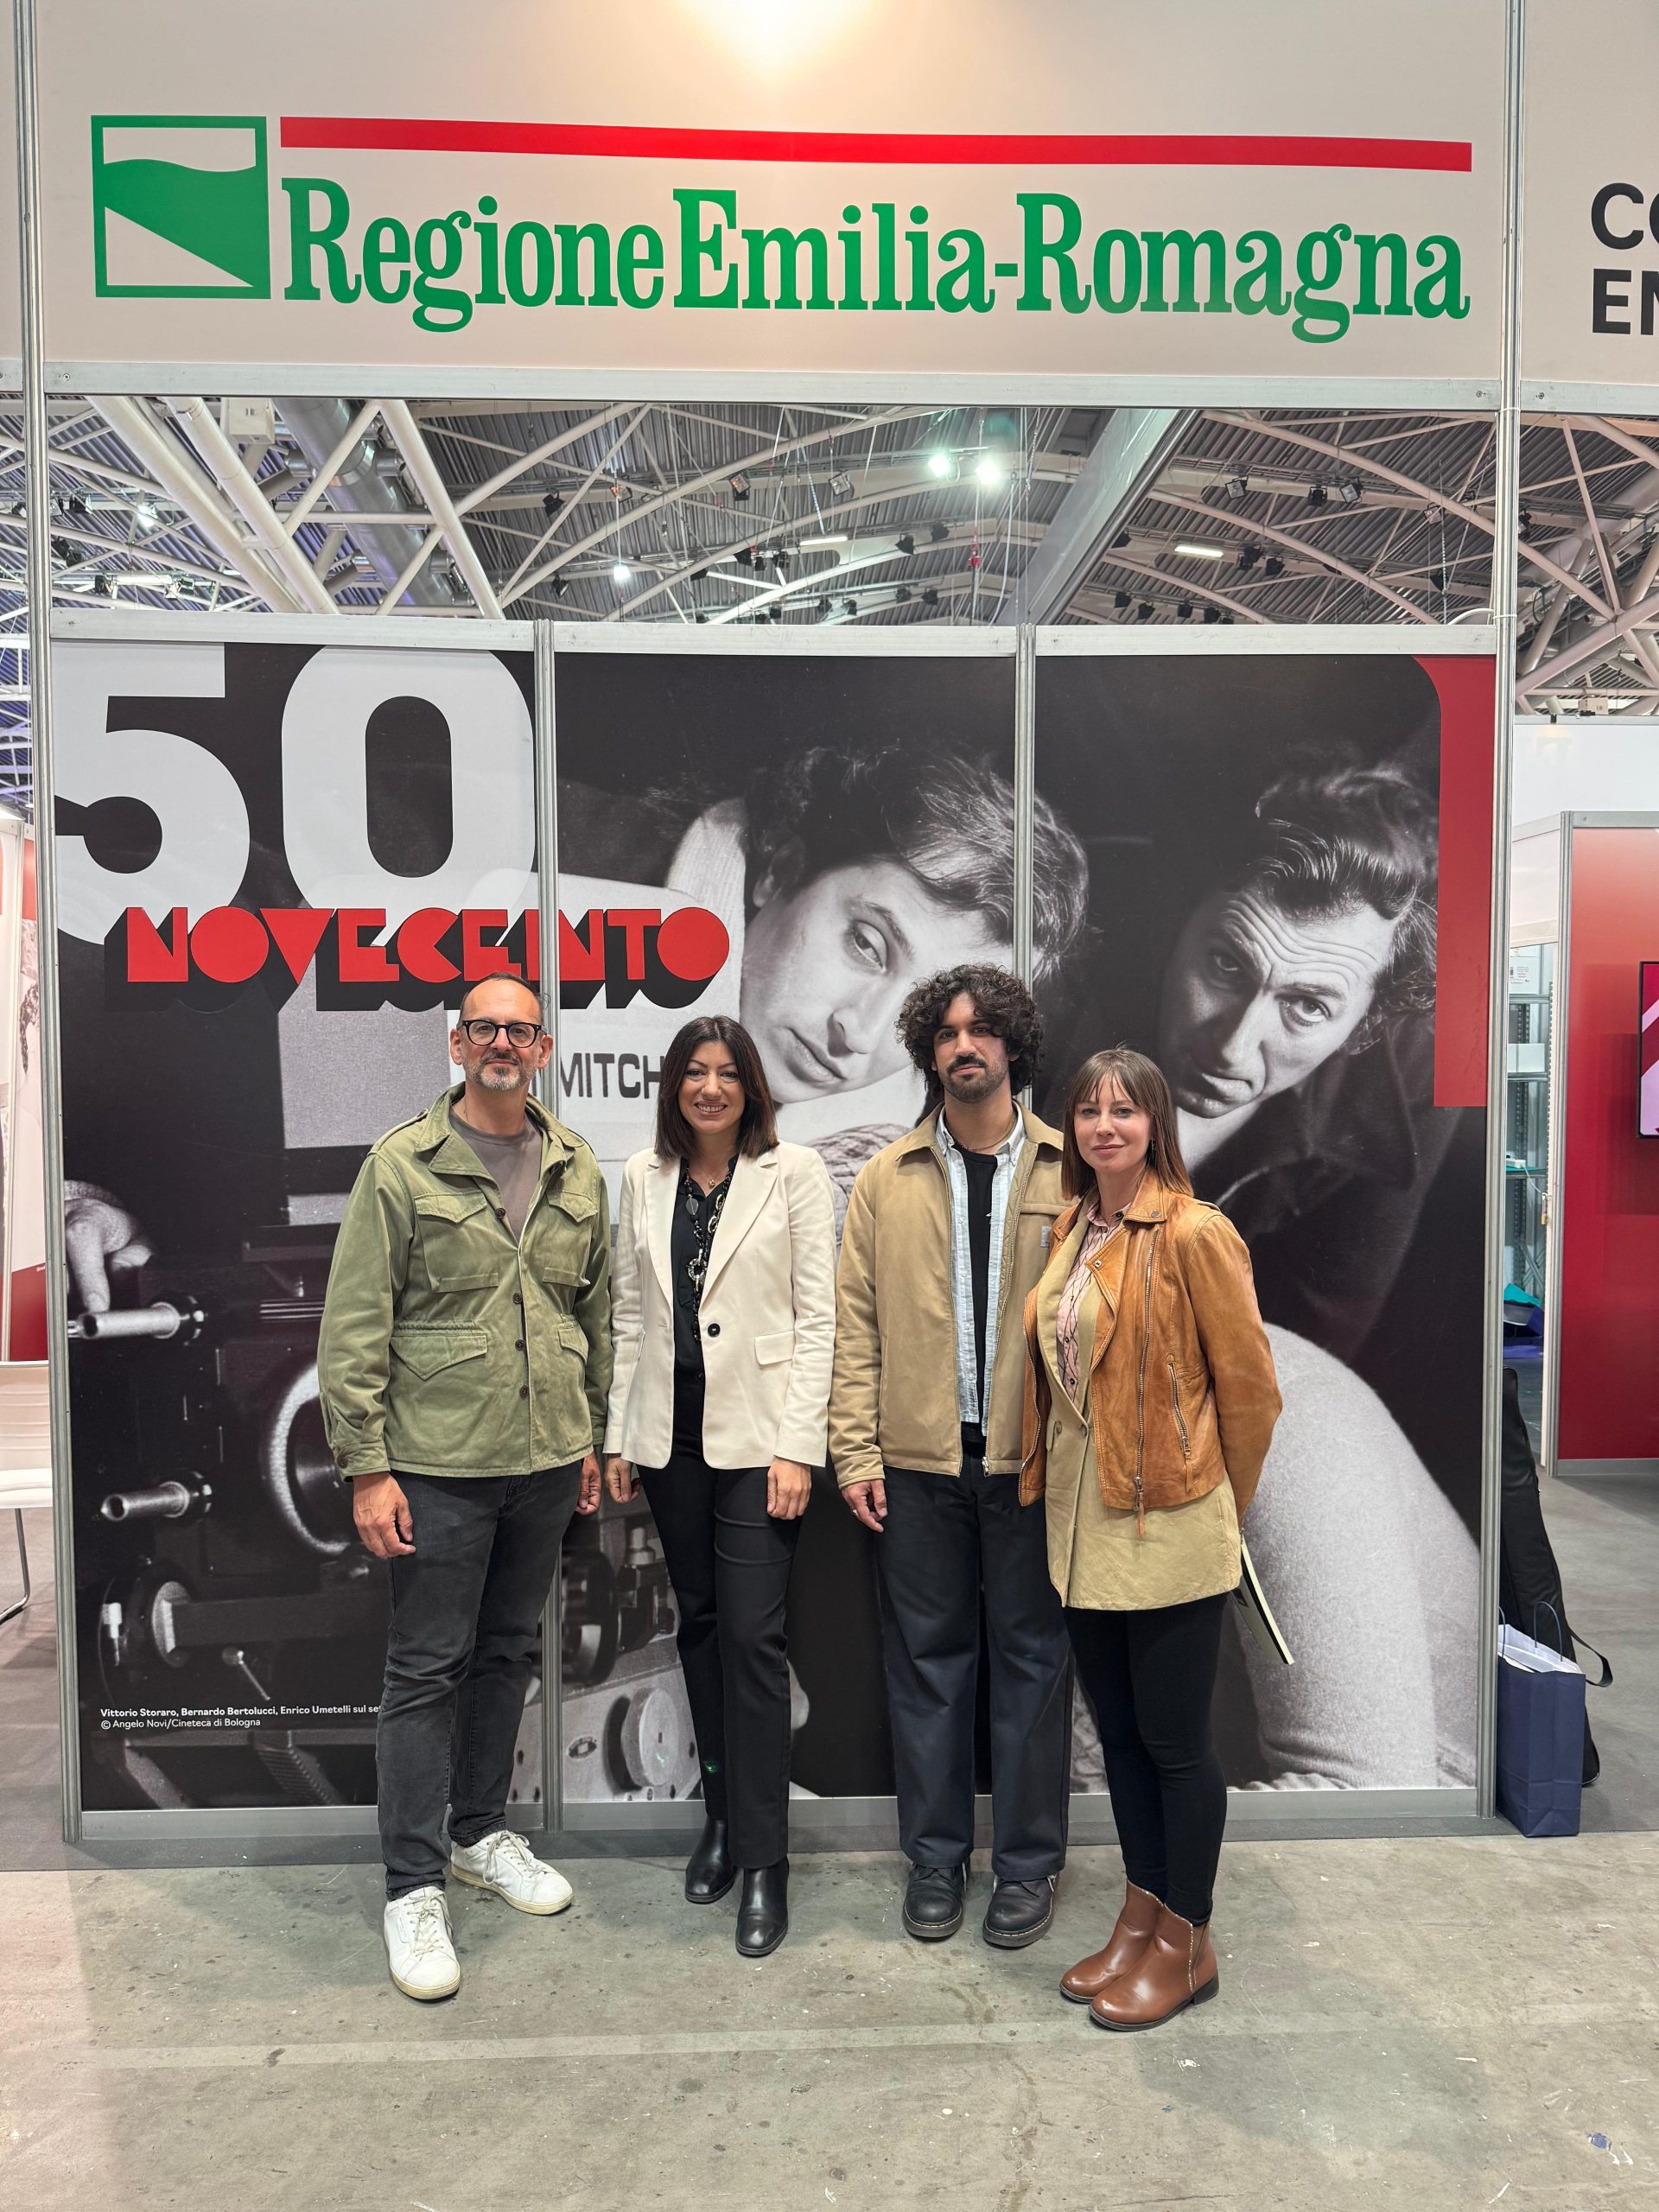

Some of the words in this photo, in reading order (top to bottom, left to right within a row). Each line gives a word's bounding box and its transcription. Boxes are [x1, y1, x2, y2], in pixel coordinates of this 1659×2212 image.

[1591, 182, 1659, 250] C
[54, 642, 537, 945] 50
[126, 906, 730, 985] NOVECENTO
[100, 1708, 138, 1717] Vittorio
[140, 1707, 179, 1718] Storaro,
[181, 1707, 226, 1716] Bernardo
[227, 1706, 278, 1716] Bertolucci,
[280, 1706, 310, 1714] Enrico
[312, 1705, 351, 1714] Umetelli
[353, 1705, 366, 1713] sul
[112, 1719, 144, 1730] Angelo
[146, 1718, 212, 1729] Novi/Cineteca
[213, 1718, 222, 1726] di
[225, 1718, 261, 1728] Bologna
